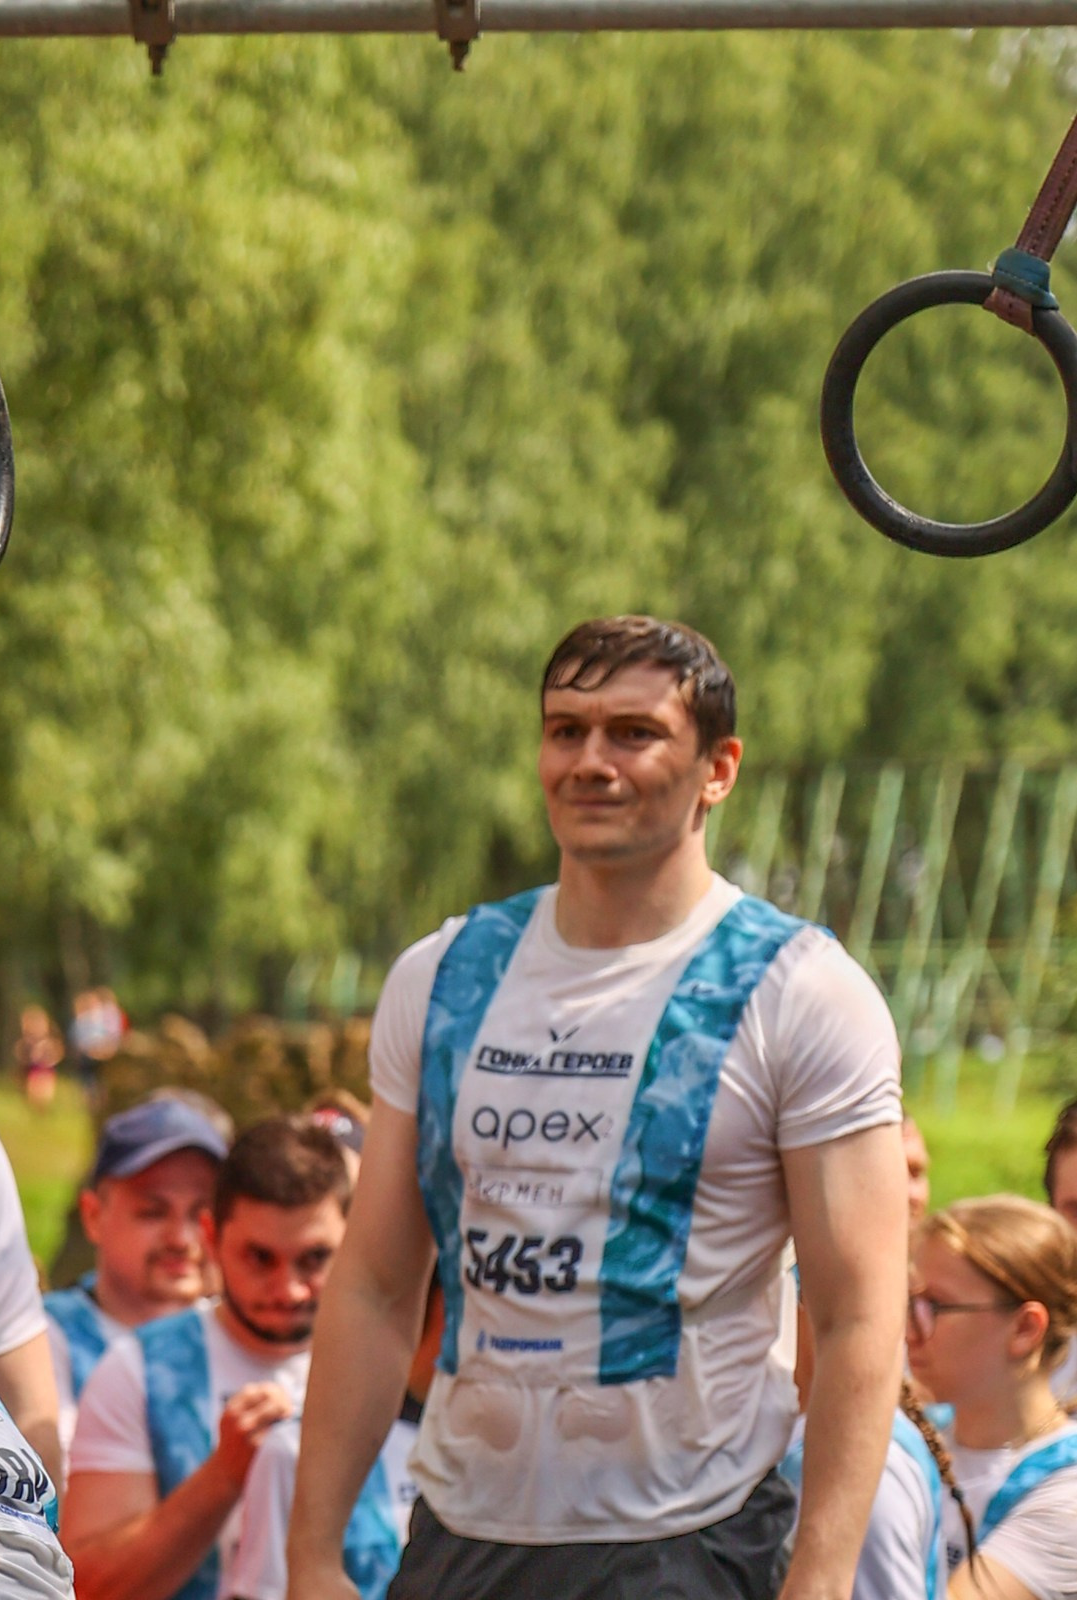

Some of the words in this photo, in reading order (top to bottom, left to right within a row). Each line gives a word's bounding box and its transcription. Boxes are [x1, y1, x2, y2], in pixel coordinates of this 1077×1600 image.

[548, 1051, 634, 1070] ГЕРОЕВ
[472, 1106, 605, 1150] apex
[466, 1229, 584, 1297] 5453
